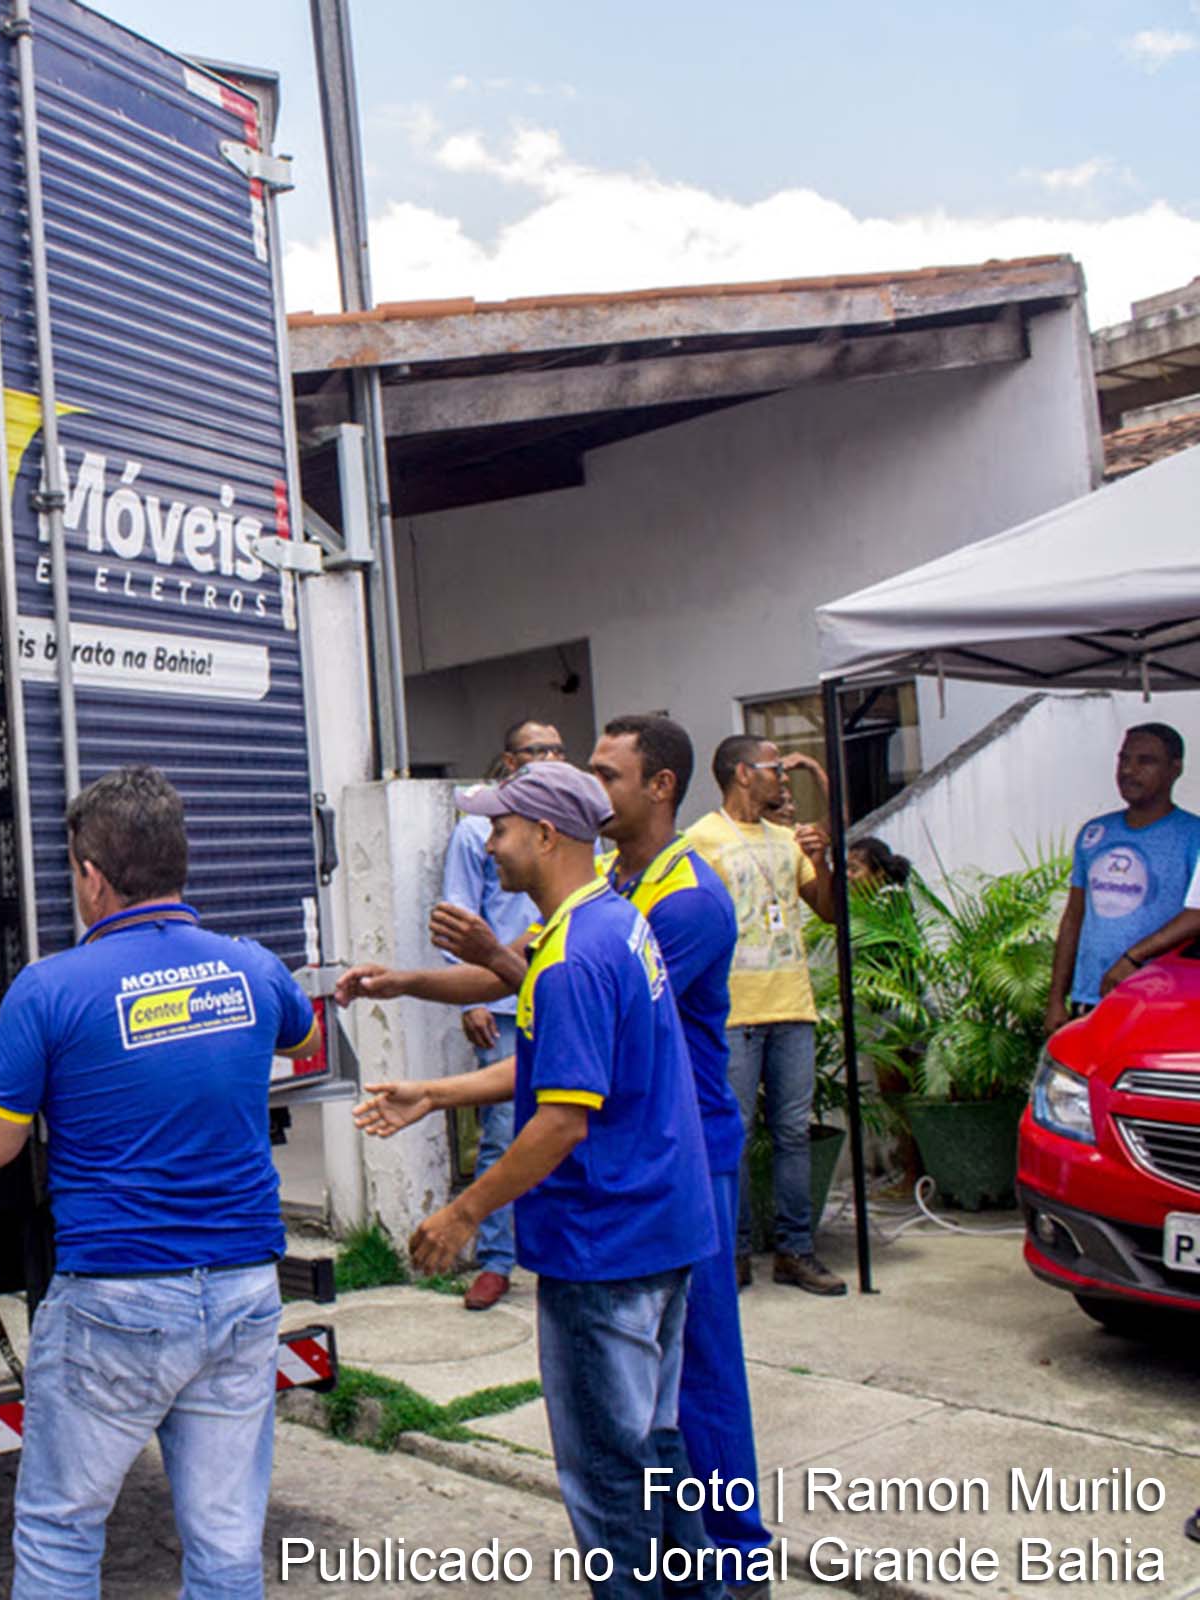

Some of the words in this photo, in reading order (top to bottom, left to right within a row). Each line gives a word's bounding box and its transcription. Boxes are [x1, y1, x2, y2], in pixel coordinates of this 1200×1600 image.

[38, 445, 263, 581] Móveis
[95, 568, 266, 616] ELETROS
[44, 632, 116, 666] brato
[122, 646, 146, 669] na
[154, 646, 213, 676] Bahia!
[121, 960, 230, 992] MOTORISTA
[1175, 1234, 1200, 1264] P
